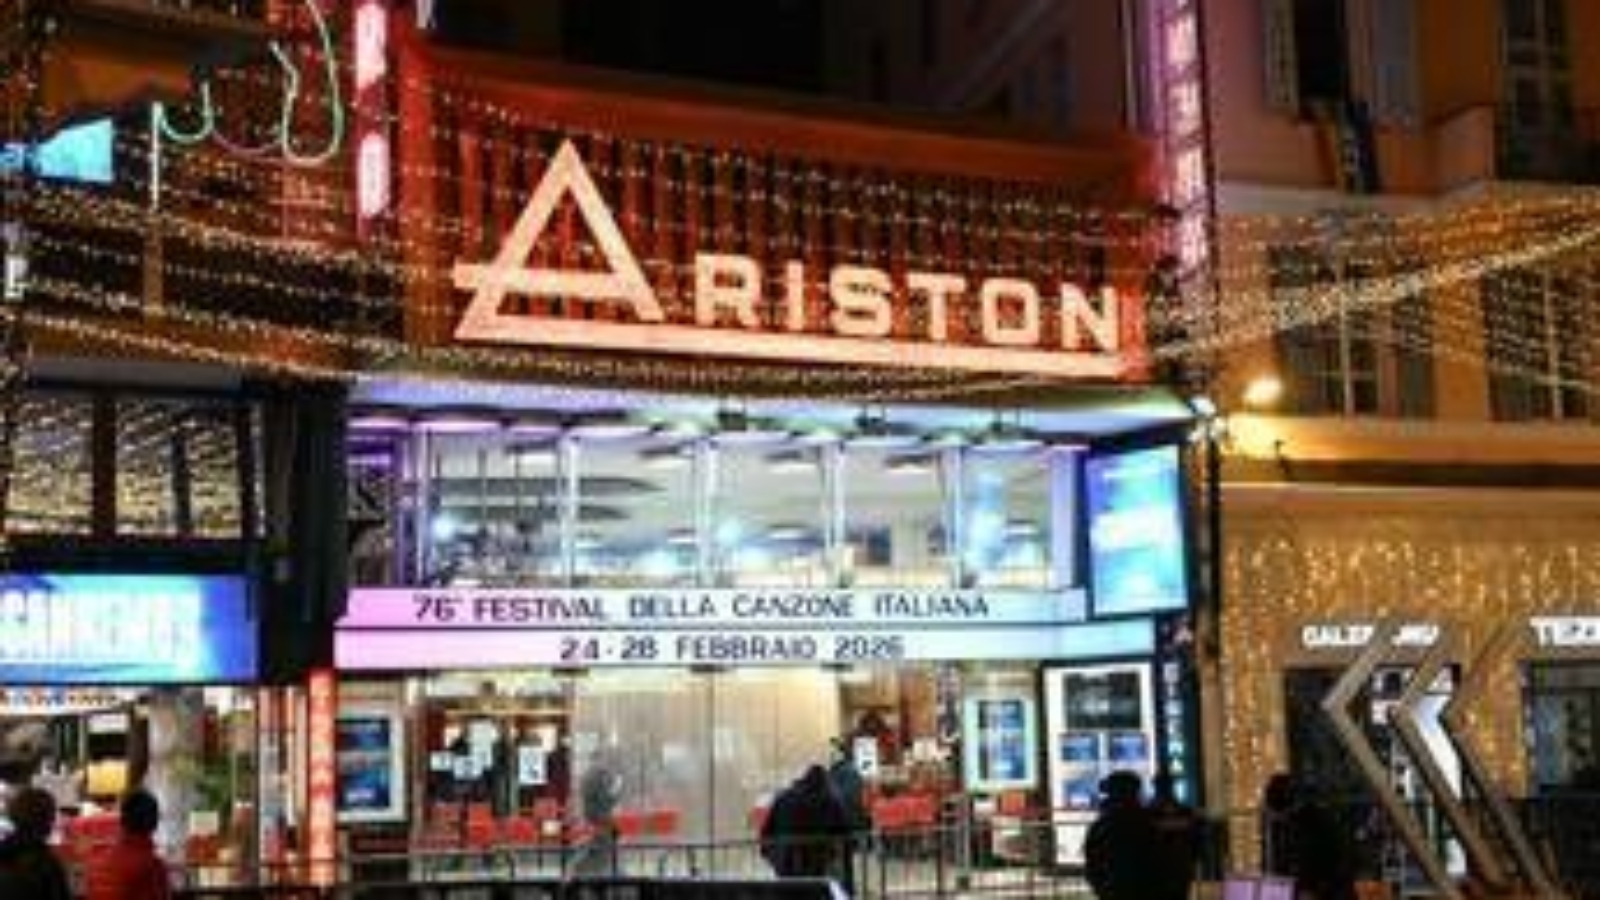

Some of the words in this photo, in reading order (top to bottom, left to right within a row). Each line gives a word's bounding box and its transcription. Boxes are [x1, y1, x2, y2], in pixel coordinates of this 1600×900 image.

[453, 139, 1121, 377] ARISTON
[474, 595, 607, 622] FESTIVAL
[628, 594, 717, 619] DELLA
[732, 593, 855, 618] CANZONE
[875, 593, 990, 618] ITALIANA
[676, 634, 817, 660] FEBBRAIO
[834, 633, 905, 660] 2026
